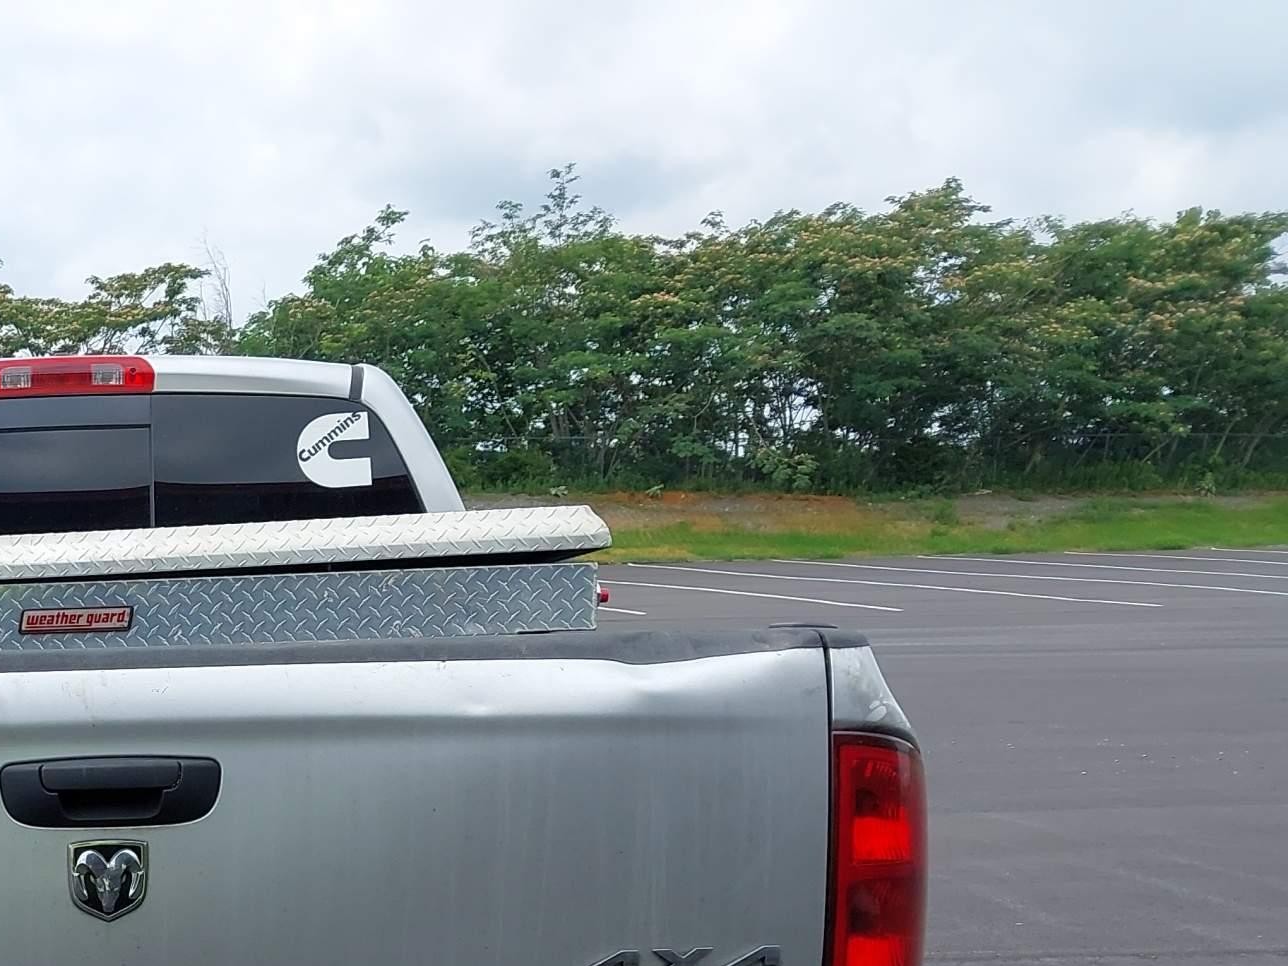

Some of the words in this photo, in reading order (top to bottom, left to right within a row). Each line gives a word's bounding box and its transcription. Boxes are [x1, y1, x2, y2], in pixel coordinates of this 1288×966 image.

[298, 411, 362, 462] Cummins
[26, 611, 83, 625] weather
[86, 609, 126, 626] guard
